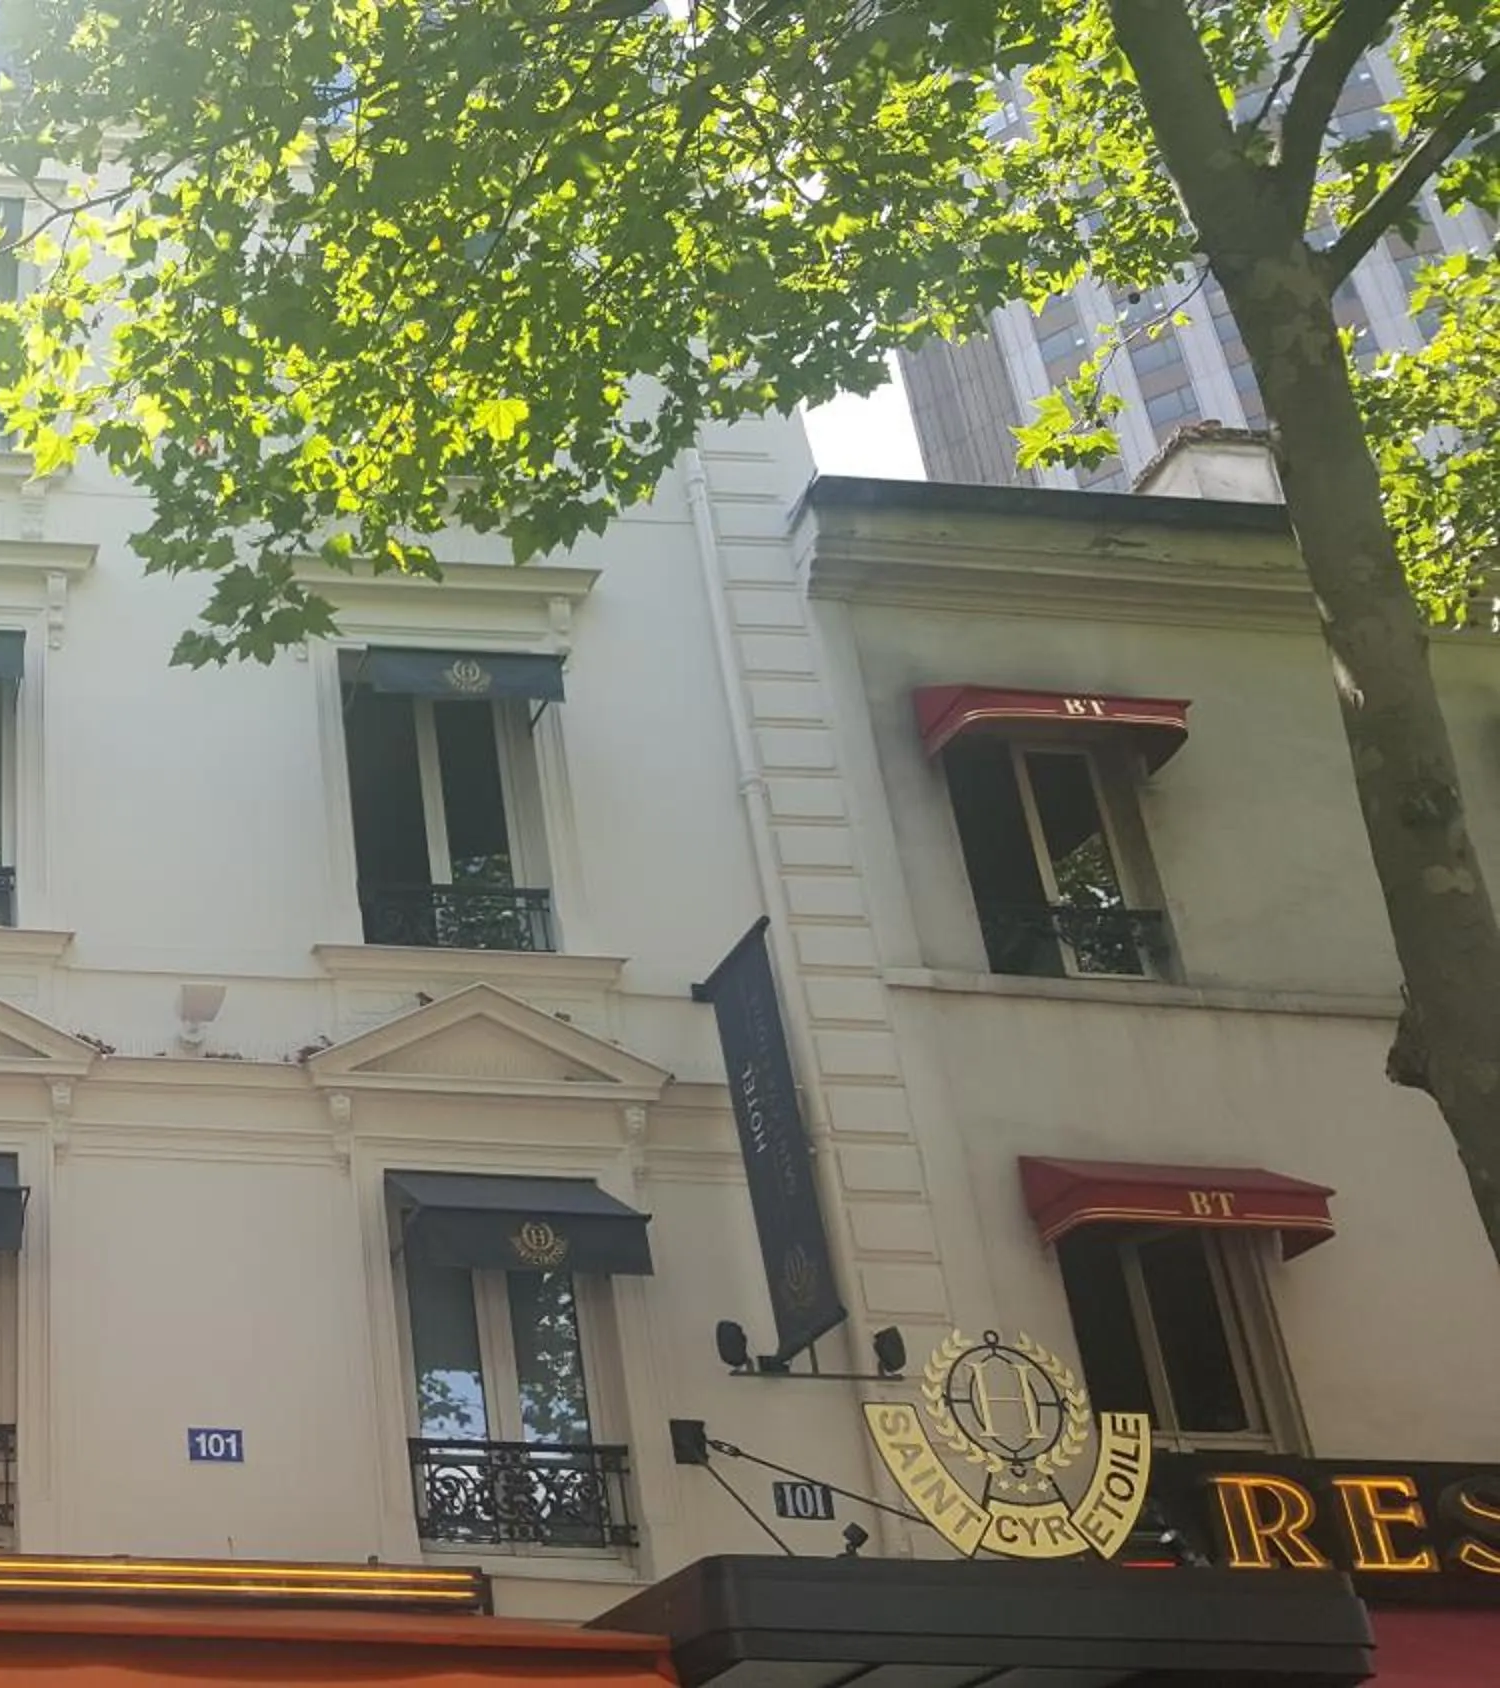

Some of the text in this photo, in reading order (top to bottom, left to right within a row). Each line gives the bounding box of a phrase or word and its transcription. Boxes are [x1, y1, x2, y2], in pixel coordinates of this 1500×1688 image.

[1062, 698, 1106, 716] BT
[741, 1062, 768, 1153] HOTEL
[1188, 1190, 1234, 1217] BT
[195, 1432, 237, 1457] 101
[878, 1408, 1141, 1549] SAINT CYR ETOILE
